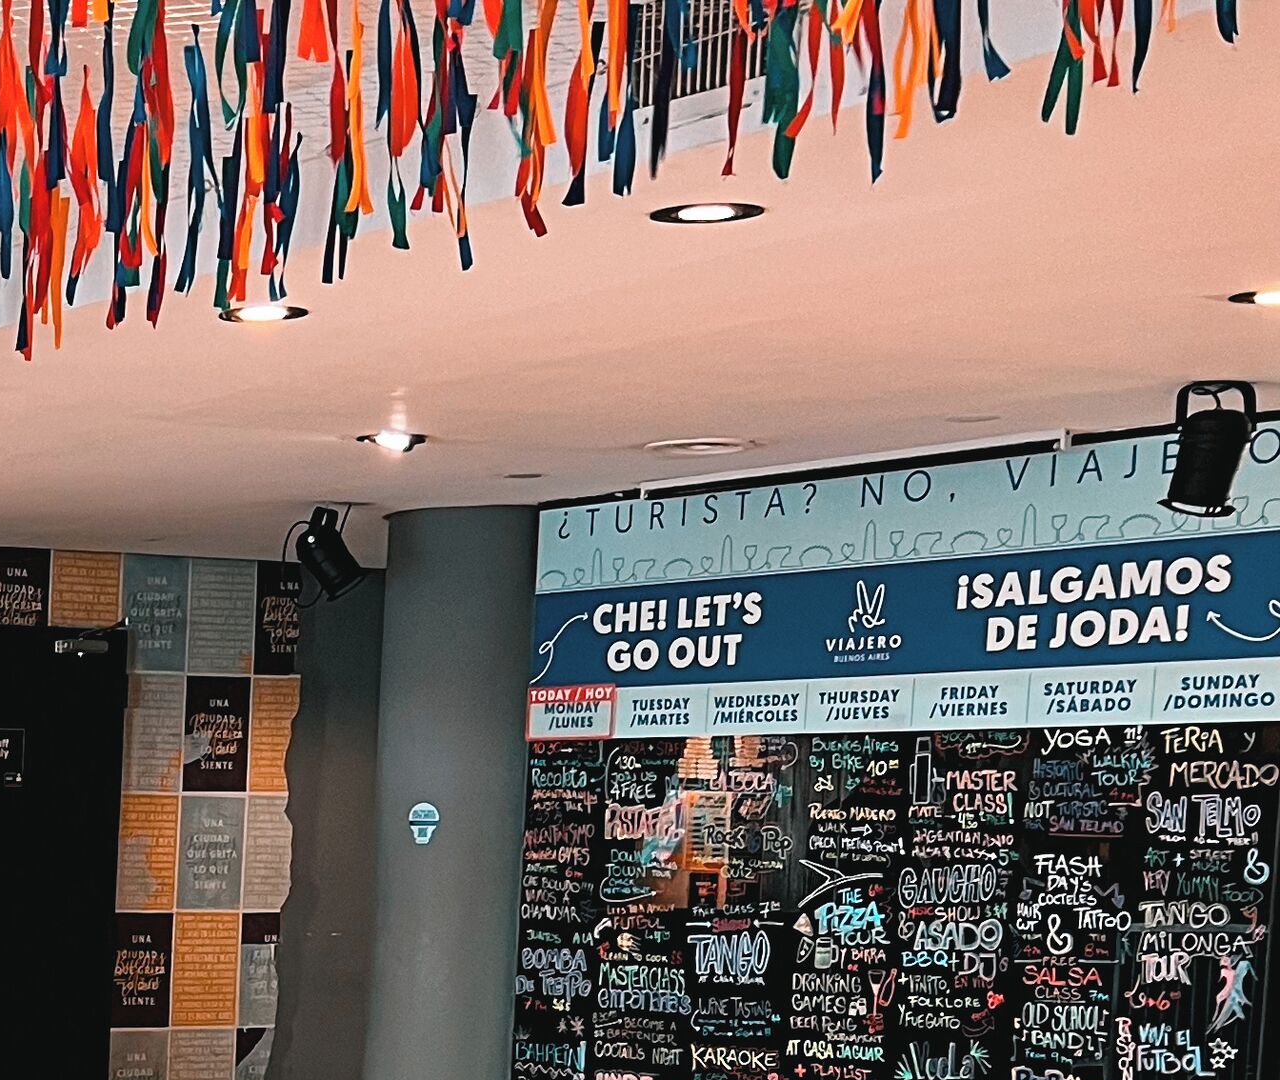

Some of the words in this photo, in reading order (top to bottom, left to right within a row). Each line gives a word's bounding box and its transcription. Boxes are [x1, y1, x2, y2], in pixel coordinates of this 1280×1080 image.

[558, 482, 817, 540] ¿TURISTA?
[860, 468, 956, 508] NO,
[1005, 428, 1280, 491] VIAJEO
[956, 554, 1232, 610] ¡SALGAMOS
[593, 600, 667, 635] CHE!
[677, 592, 762, 629] LET'S
[986, 614, 1037, 652] DE
[1049, 605, 1189, 648] JODA!
[826, 634, 902, 652] VIAJERO
[606, 639, 659, 672] GO
[668, 634, 742, 669] OUT
[834, 654, 865, 662] BUENOS
[867, 652, 890, 660] AIRES
[1044, 679, 1137, 696] SATURDAY
[1181, 674, 1260, 691] SUNDAY
[531, 689, 570, 702] TODAY
[585, 686, 613, 700] HOY
[714, 693, 800, 709] WEDNESDAY
[819, 688, 900, 706] THURSDAY
[941, 686, 998, 700] FRIDAY
[1163, 691, 1275, 711] /DOMINGO
[544, 702, 600, 715] MONDAY
[632, 698, 690, 711] TUESDAY
[826, 705, 890, 722] /JUEVES
[929, 701, 1008, 719] /VIERNES
[1047, 696, 1131, 715] /SÁBADO
[549, 716, 593, 730] /LUNES
[630, 712, 690, 728] /MARTES
[1040, 727, 1112, 756] YOGA
[200, 761, 233, 770] SIENTE
[946, 770, 1018, 792] MASTER
[1169, 761, 1280, 789] MERCADO
[1145, 791, 1187, 834] SAN
[1191, 793, 1261, 838] TELMO
[1033, 854, 1103, 878] FLASH
[898, 864, 997, 908] GAUCHO
[838, 887, 862, 904] THE
[935, 906, 981, 922] SHOW
[1138, 899, 1231, 929] TANGO
[132, 934, 152, 943] UNA
[915, 919, 1002, 951] ASADO
[687, 930, 770, 977] TANGO
[1022, 965, 1102, 988] SALSA
[1035, 985, 1082, 1000] CLASS
[792, 995, 846, 1015] GAMES
[908, 995, 981, 1009] FOLKLORE
[691, 1043, 779, 1071] KARAOKE
[804, 1040, 833, 1060] CASA
[836, 1044, 885, 1063] JAGUAR
